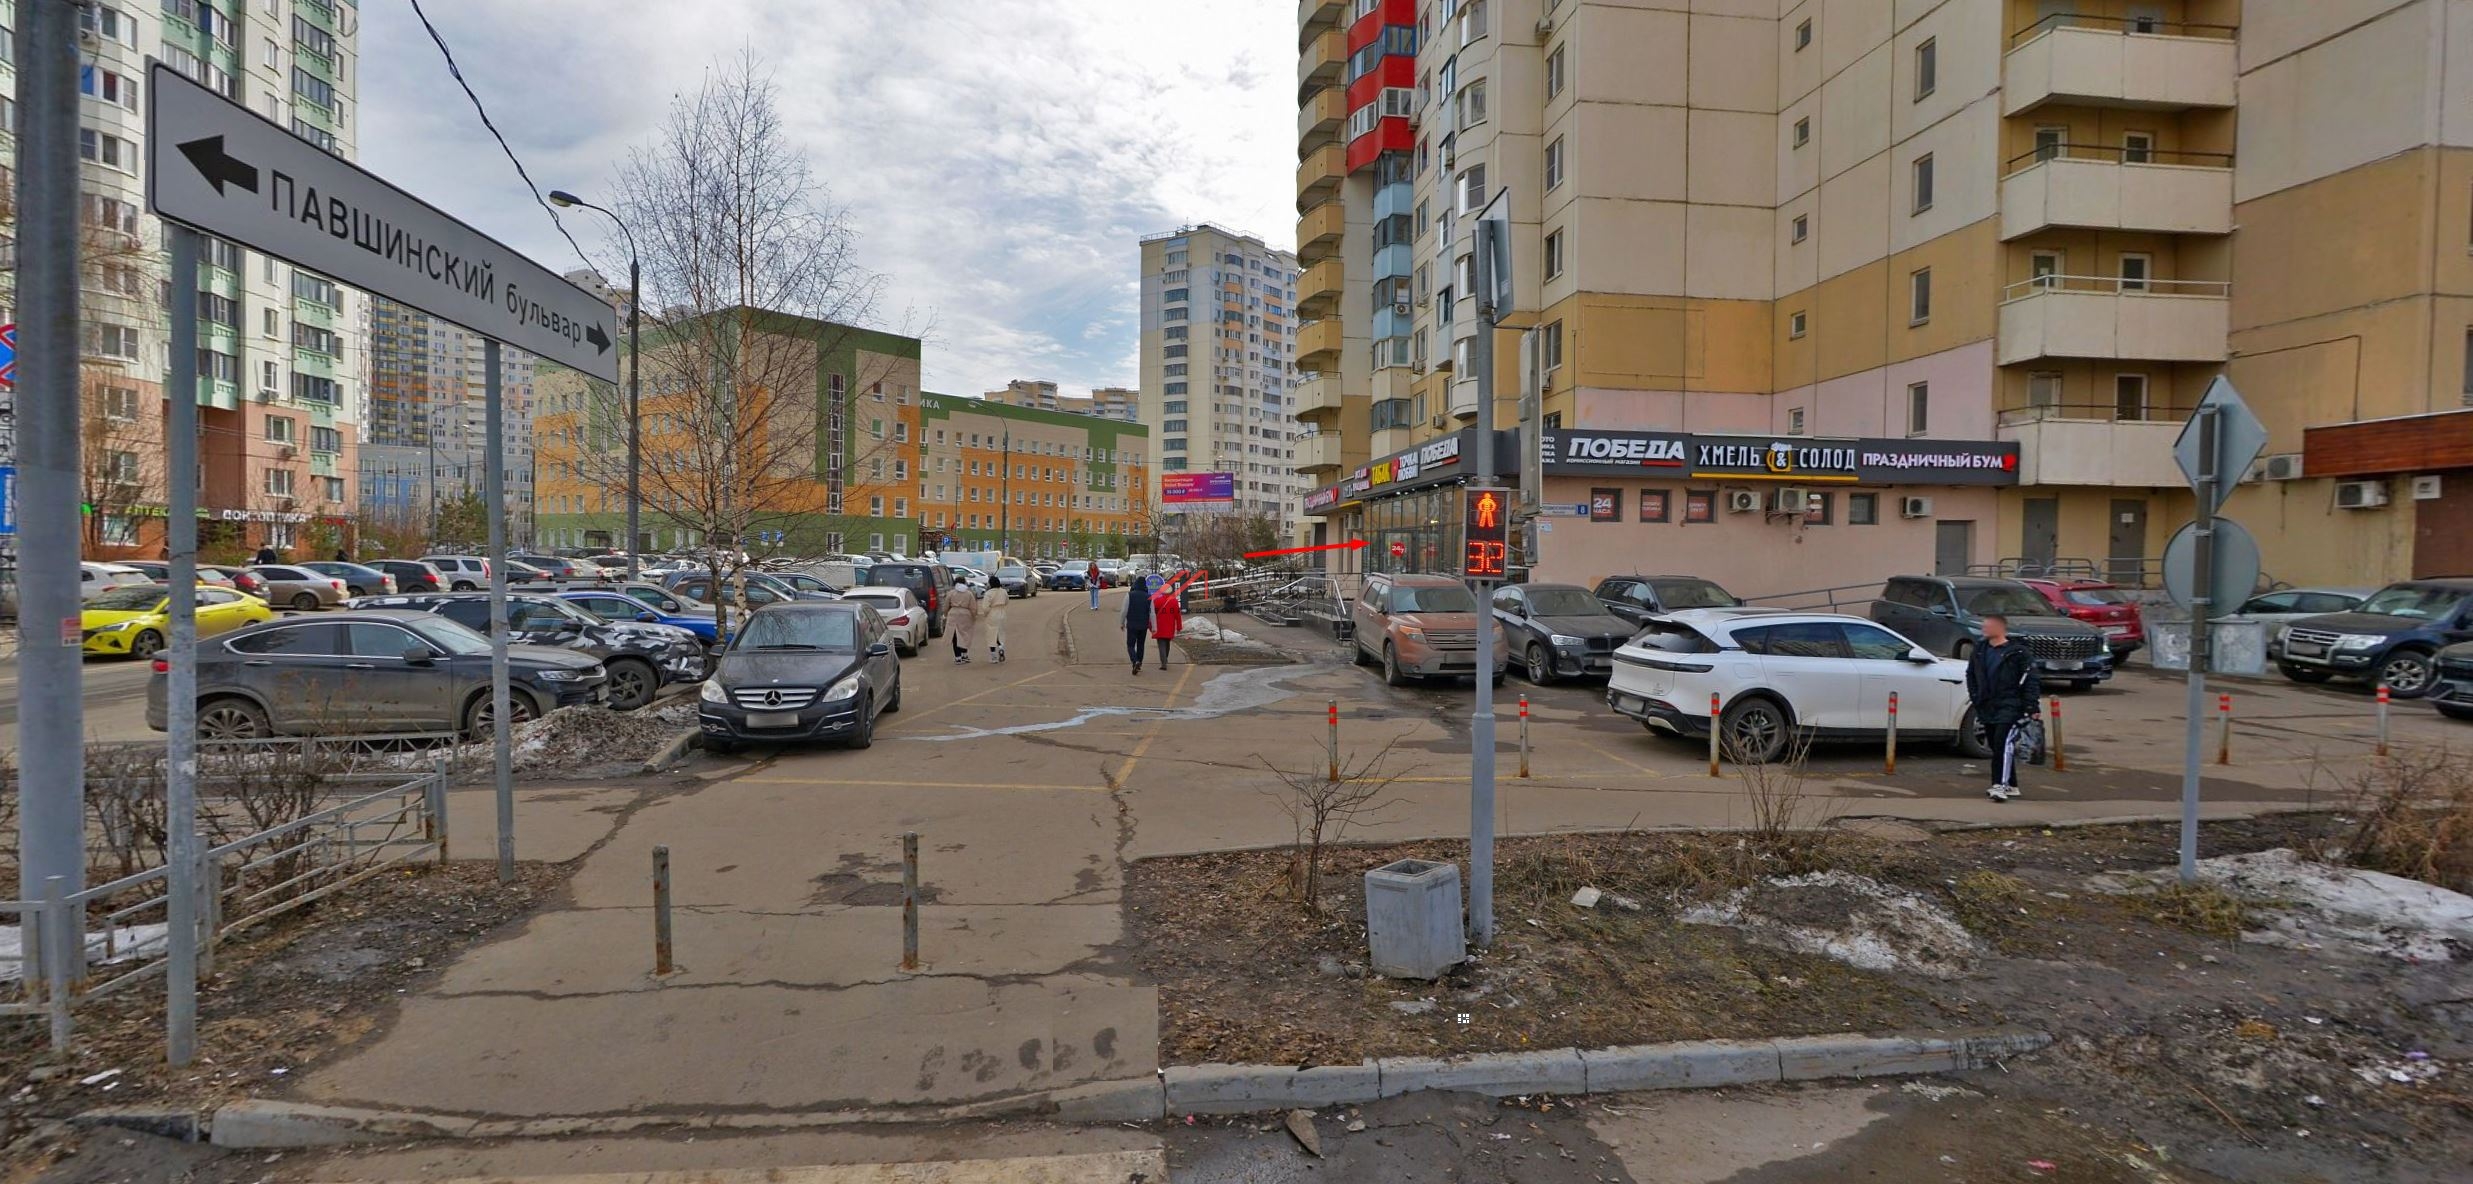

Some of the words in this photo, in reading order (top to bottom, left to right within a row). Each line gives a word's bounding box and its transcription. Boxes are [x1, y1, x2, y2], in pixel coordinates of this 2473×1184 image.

[271, 168, 495, 305] ПАВШИНСКИЙ
[505, 282, 582, 349] бульвар
[1420, 437, 1459, 464] ПОБЕДА
[1568, 437, 1685, 459] ПОБЕДА
[1699, 444, 1761, 466] ХМЕЛЬ
[1799, 448, 1856, 470] СОЛОД
[1863, 452, 1971, 468] ПРАЗДНИЧНЫЙ
[1973, 455, 2003, 468] БУМ
[1593, 498, 1613, 508] 24
[1467, 541, 1504, 573] 32
